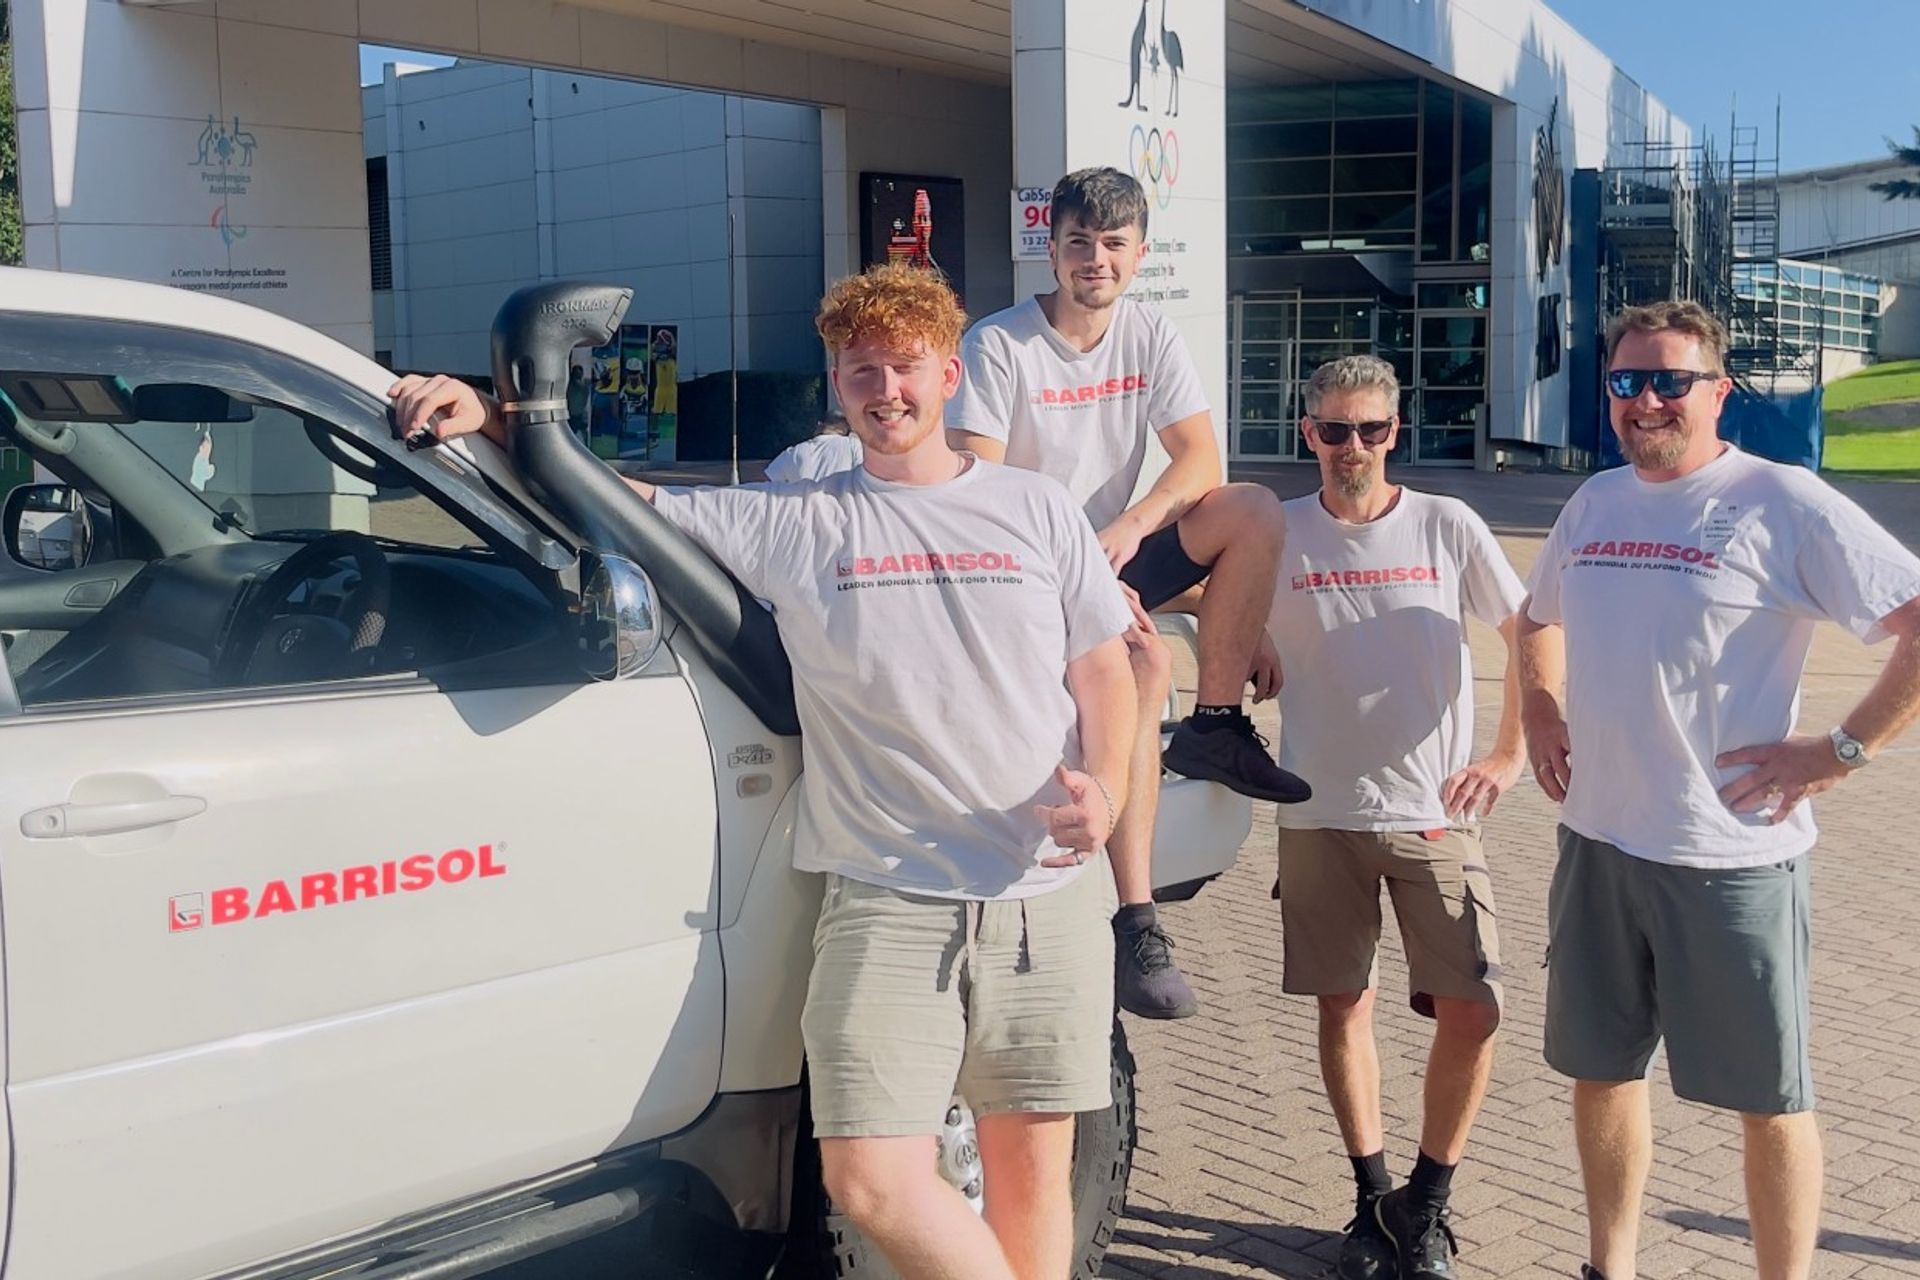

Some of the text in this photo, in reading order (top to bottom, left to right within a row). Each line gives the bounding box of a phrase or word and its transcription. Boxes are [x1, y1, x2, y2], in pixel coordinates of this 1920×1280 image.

[202, 269, 212, 277] for
[214, 268, 251, 278] Paralympic
[252, 268, 286, 276] Excellence
[540, 299, 608, 314] IRONMAN
[1582, 541, 1719, 569] BARRISOL
[854, 551, 1022, 575] BARRISOL
[1594, 560, 1628, 568] MONDIAL
[1643, 562, 1681, 572] PLAFOND
[837, 576, 1023, 591] LEADER MONDIAL DU PLAFOND TENDU
[1305, 566, 1440, 587] BARRISOL
[1198, 707, 1231, 716] FILA
[211, 844, 506, 925] BARRISOL
